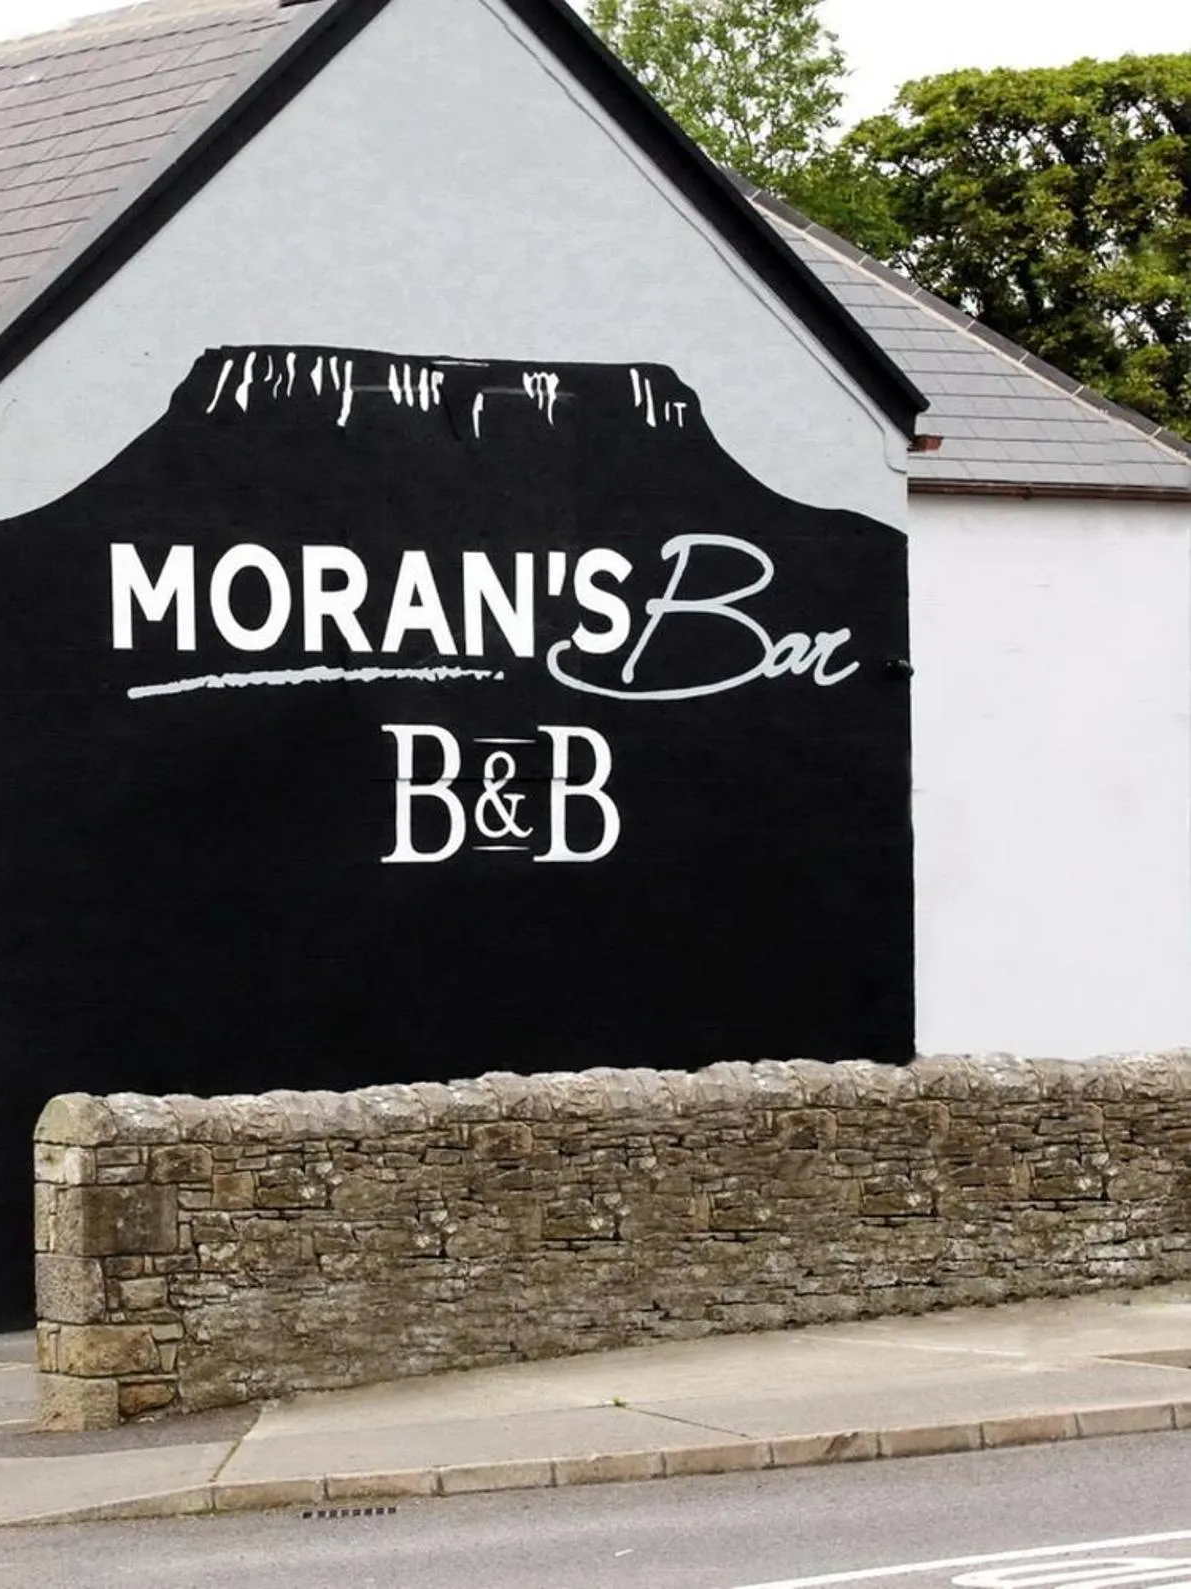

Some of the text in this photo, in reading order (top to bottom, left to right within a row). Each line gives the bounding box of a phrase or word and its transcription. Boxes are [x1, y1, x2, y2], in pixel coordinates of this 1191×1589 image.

[110, 534, 859, 700] MORAN'S Bar
[381, 724, 621, 864] B&B
